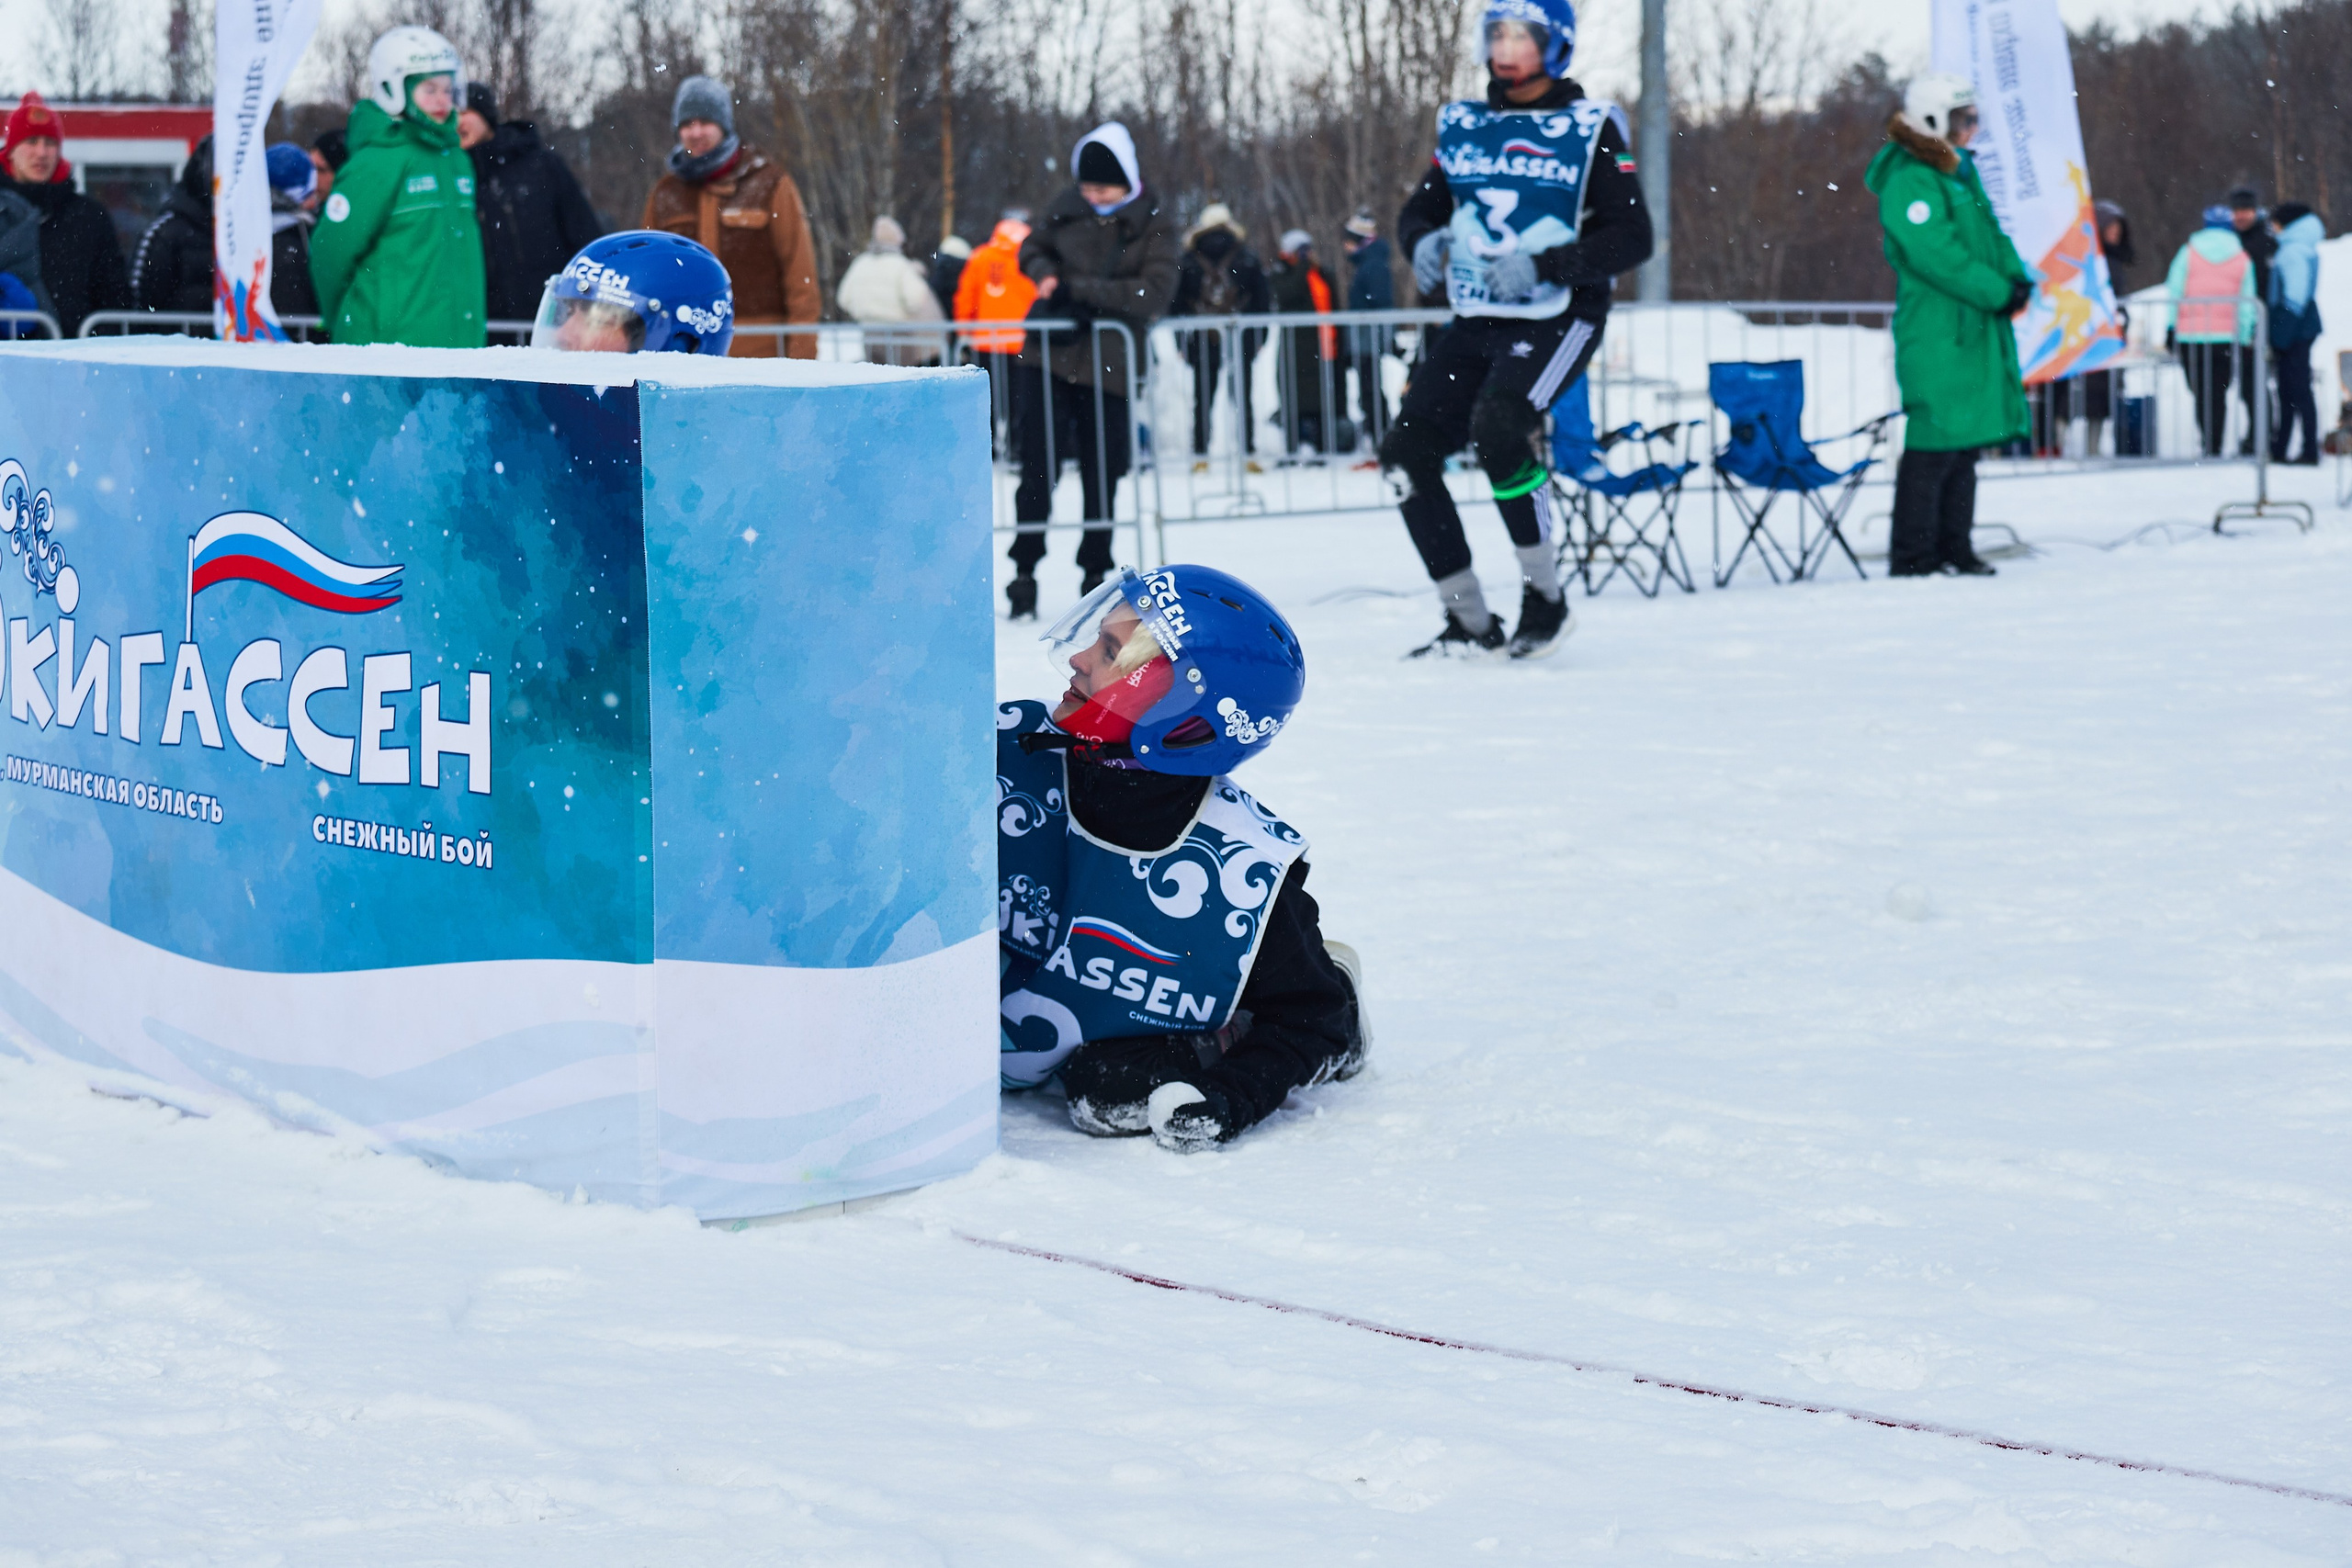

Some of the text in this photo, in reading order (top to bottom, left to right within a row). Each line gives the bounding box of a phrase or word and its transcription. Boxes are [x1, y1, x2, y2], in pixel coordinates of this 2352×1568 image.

[1469, 187, 1520, 257] 3
[1152, 627, 1179, 662] РОССИИ
[1156, 616, 1182, 650] ПЕРВЫЕ
[0, 614, 492, 795] КИГАССЕН
[6, 753, 225, 825] МУРМАНСКАЯ ОБЛАСТЬ
[311, 813, 493, 870] СНЕЖНЫЙ БОЙ
